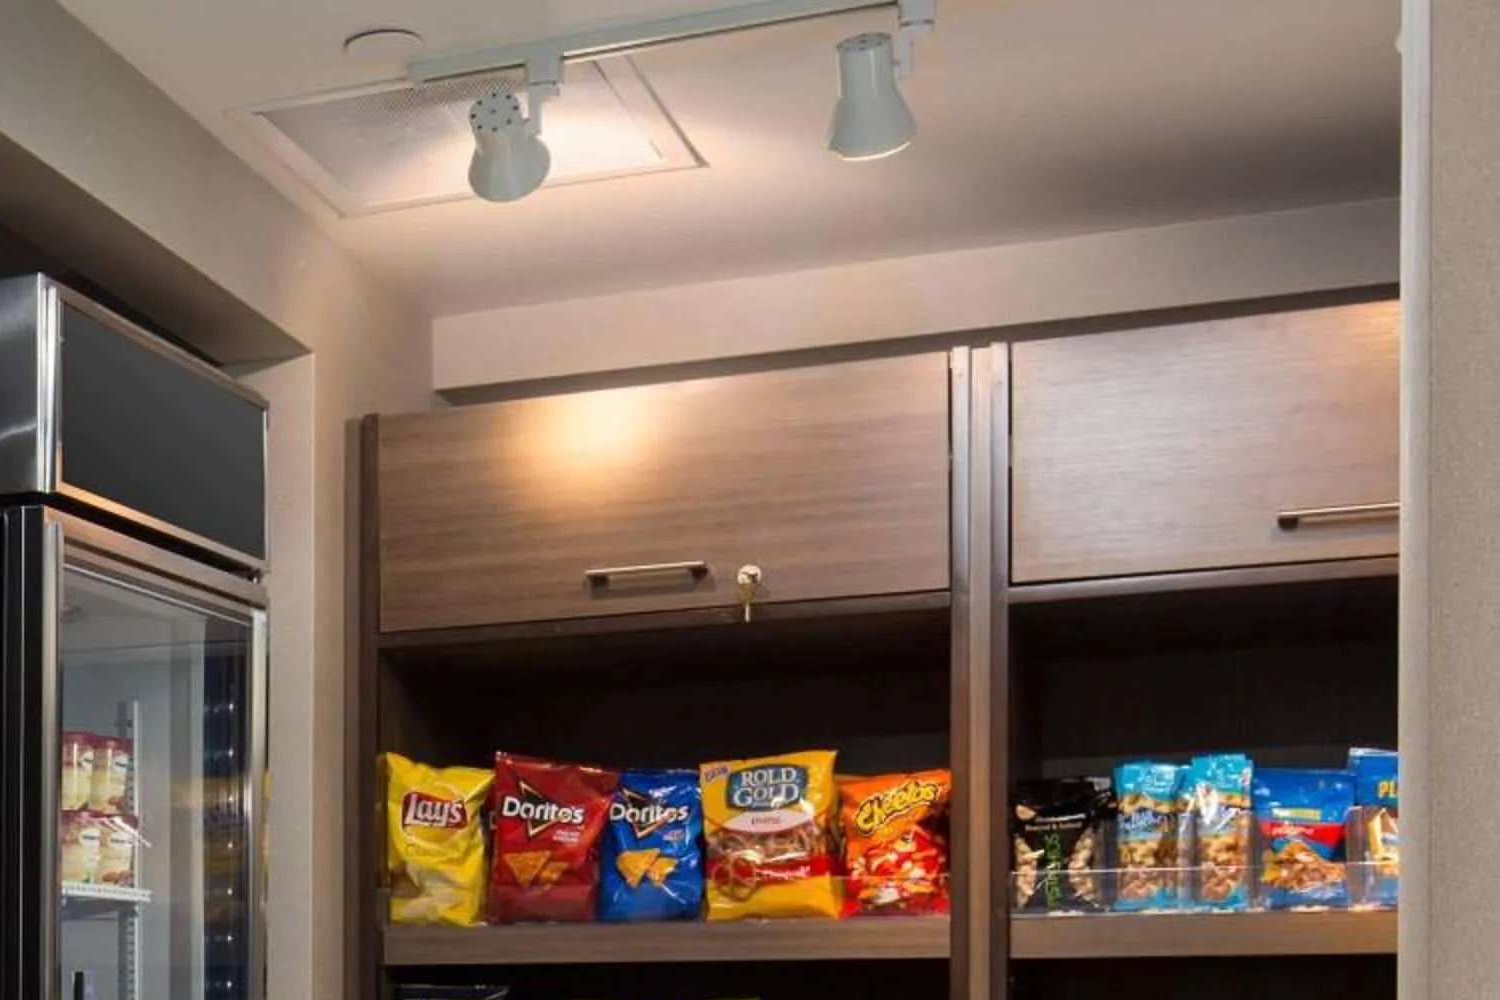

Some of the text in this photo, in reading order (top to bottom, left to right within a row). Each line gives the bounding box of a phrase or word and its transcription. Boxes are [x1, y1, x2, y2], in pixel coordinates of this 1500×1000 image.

[741, 767, 797, 788] ROLD
[733, 782, 800, 808] GOLD
[856, 782, 936, 832] Cheetos
[403, 792, 464, 827] Lay's
[502, 796, 585, 824] Doritos
[609, 801, 690, 826] Doritos
